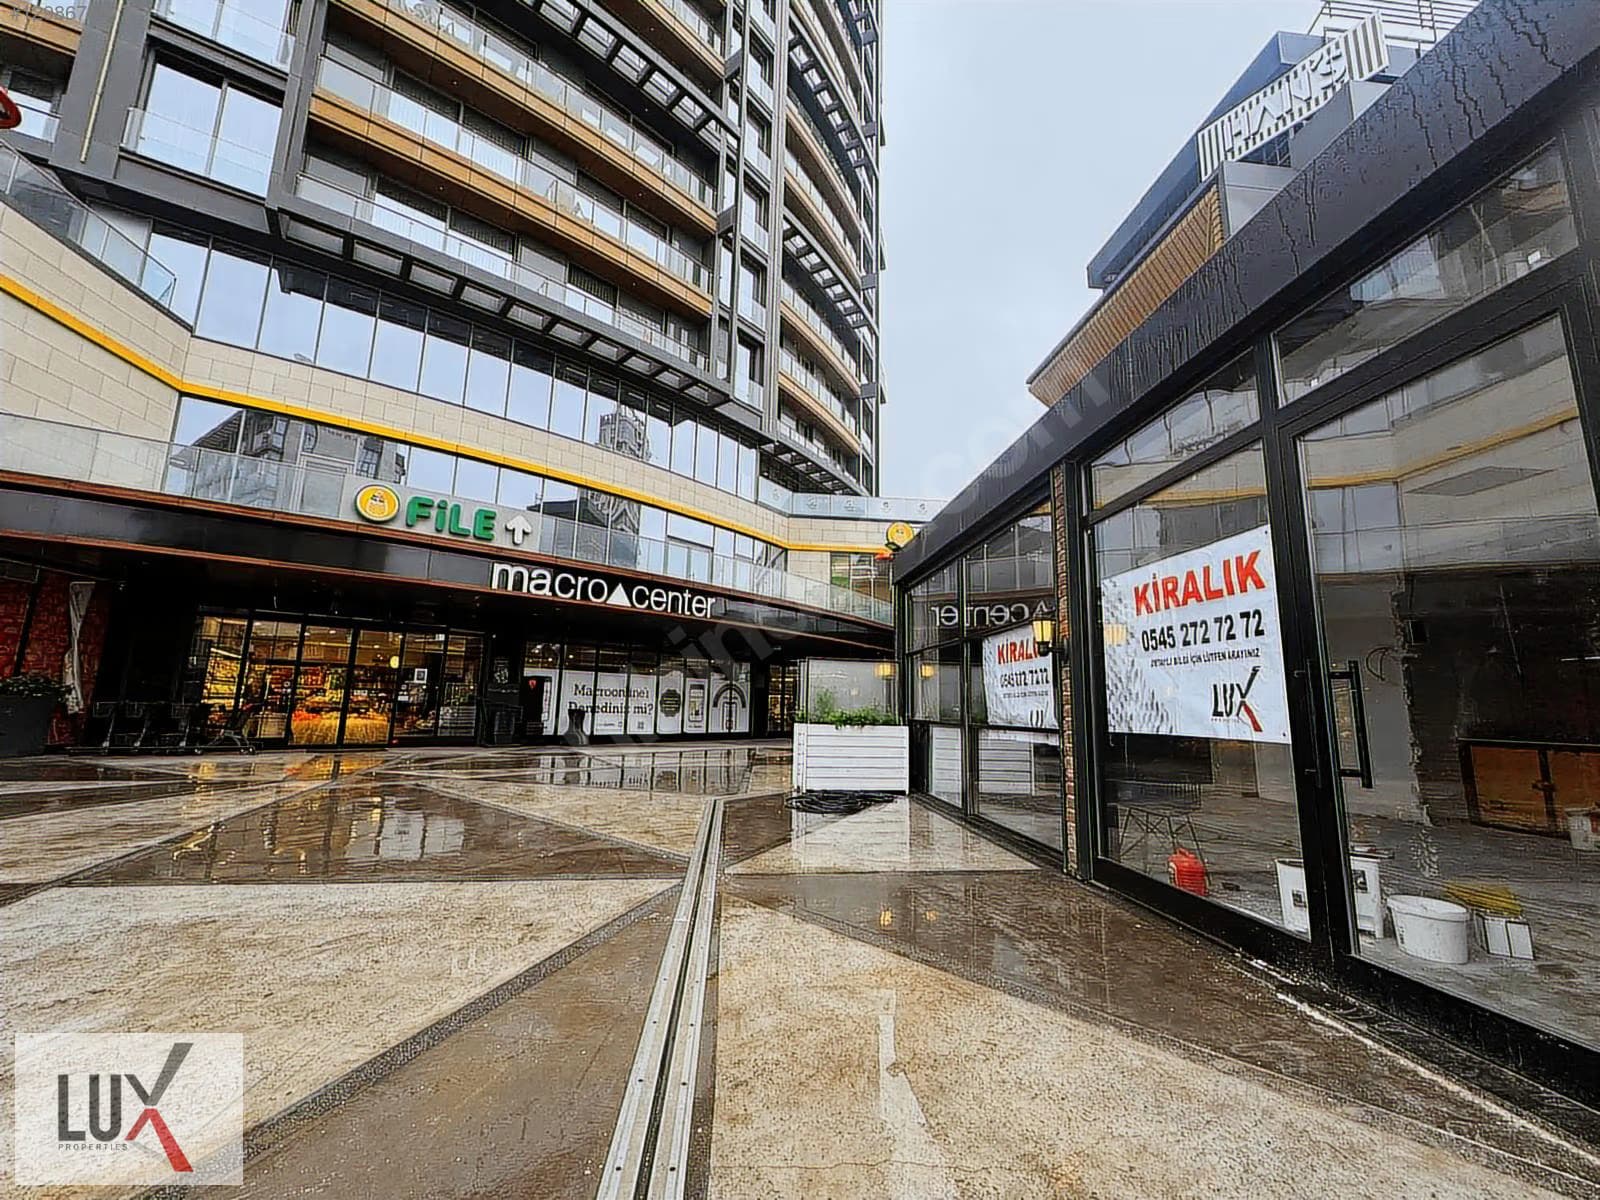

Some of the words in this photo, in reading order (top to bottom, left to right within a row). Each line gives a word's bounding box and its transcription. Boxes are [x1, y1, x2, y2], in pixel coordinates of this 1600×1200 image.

[491, 563, 608, 603] macro
[632, 585, 716, 618] center
[1133, 550, 1266, 616] KİRALIK
[997, 638, 1039, 665] KİRALI
[1141, 624, 1176, 651] 0545
[1180, 620, 1211, 647] 272
[1214, 615, 1236, 642] 72
[1240, 609, 1265, 638] 72
[1212, 666, 1263, 732] LUX
